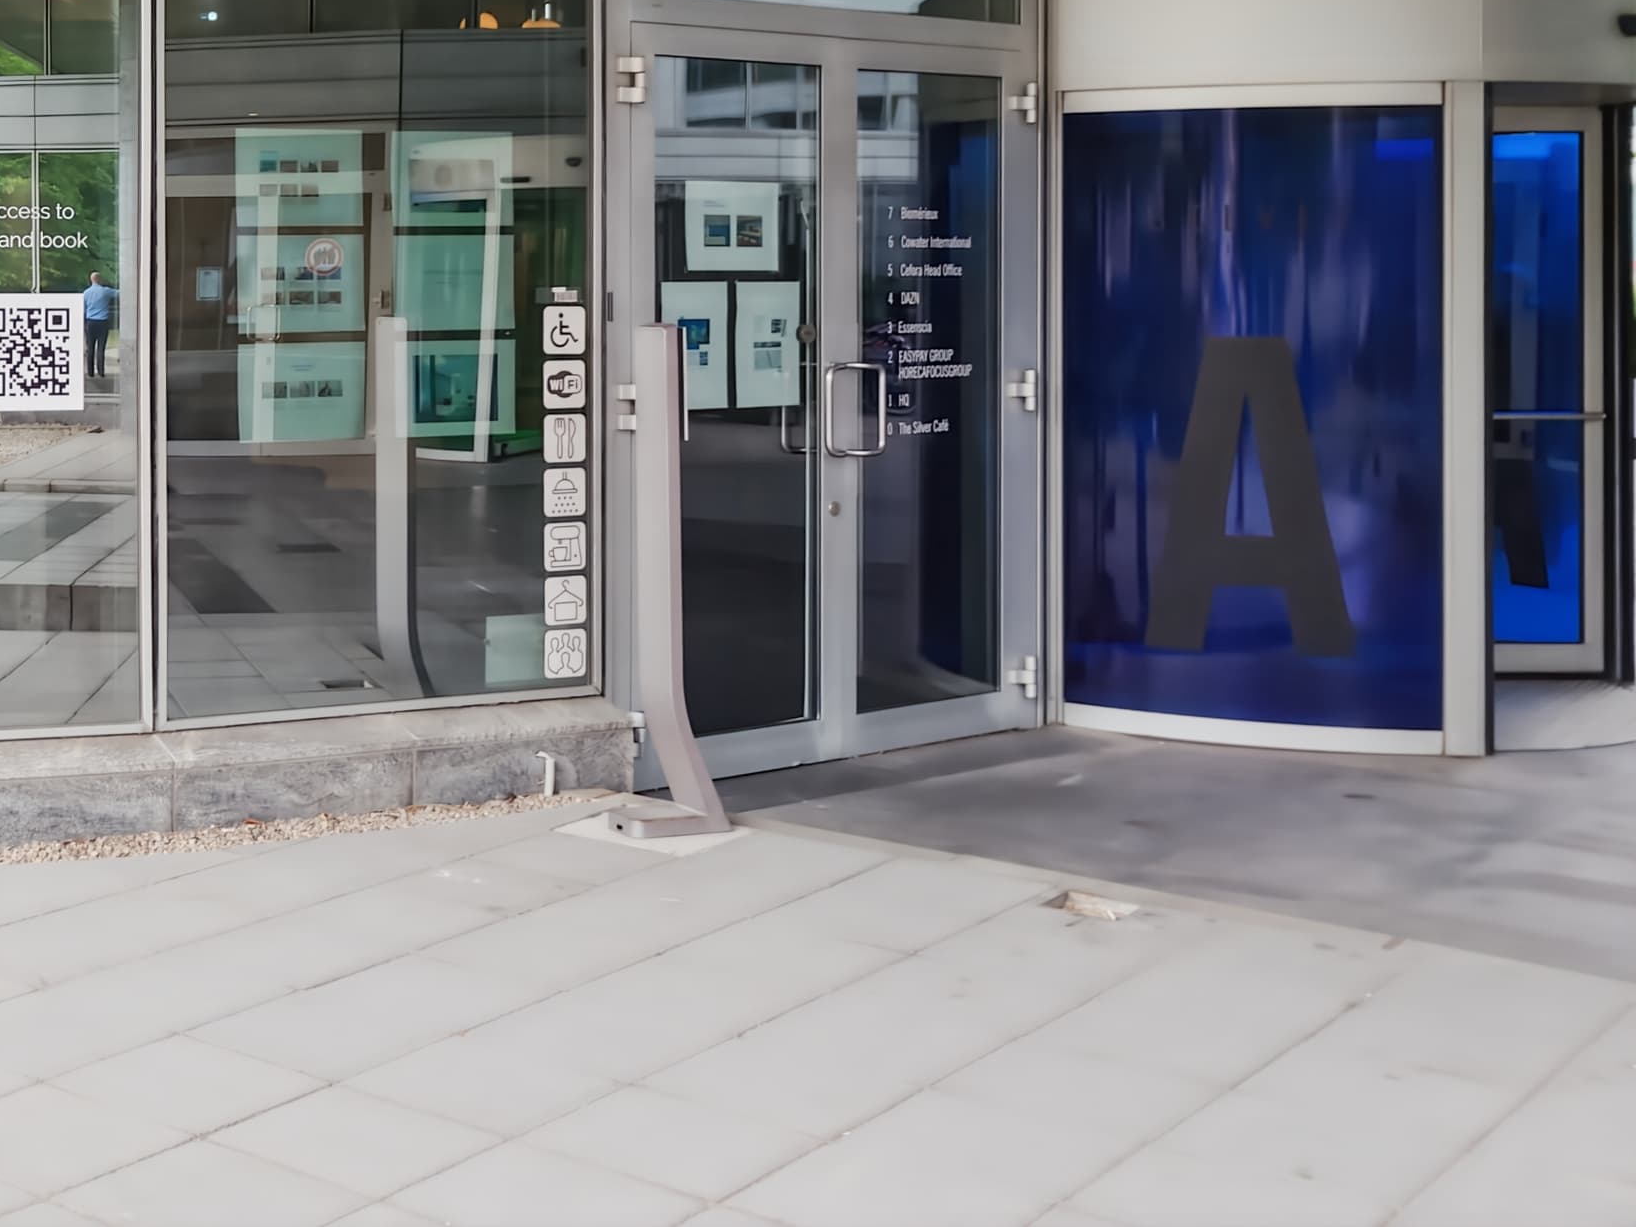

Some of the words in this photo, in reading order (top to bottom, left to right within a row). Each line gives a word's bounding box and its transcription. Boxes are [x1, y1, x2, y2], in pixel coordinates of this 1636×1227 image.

[55, 203, 75, 220] to
[887, 206, 894, 220] 7
[39, 231, 89, 249] book
[887, 235, 894, 248] 6
[887, 264, 893, 277] 5
[887, 292, 894, 305] 4
[900, 291, 920, 305] DAZN
[887, 321, 893, 334] 3
[887, 350, 894, 363] 2
[929, 348, 954, 362] GROUP
[888, 393, 893, 407] 1
[898, 393, 910, 407] HQ
[887, 422, 893, 435] 0
[898, 421, 912, 435] The
[1144, 335, 1357, 658] A
